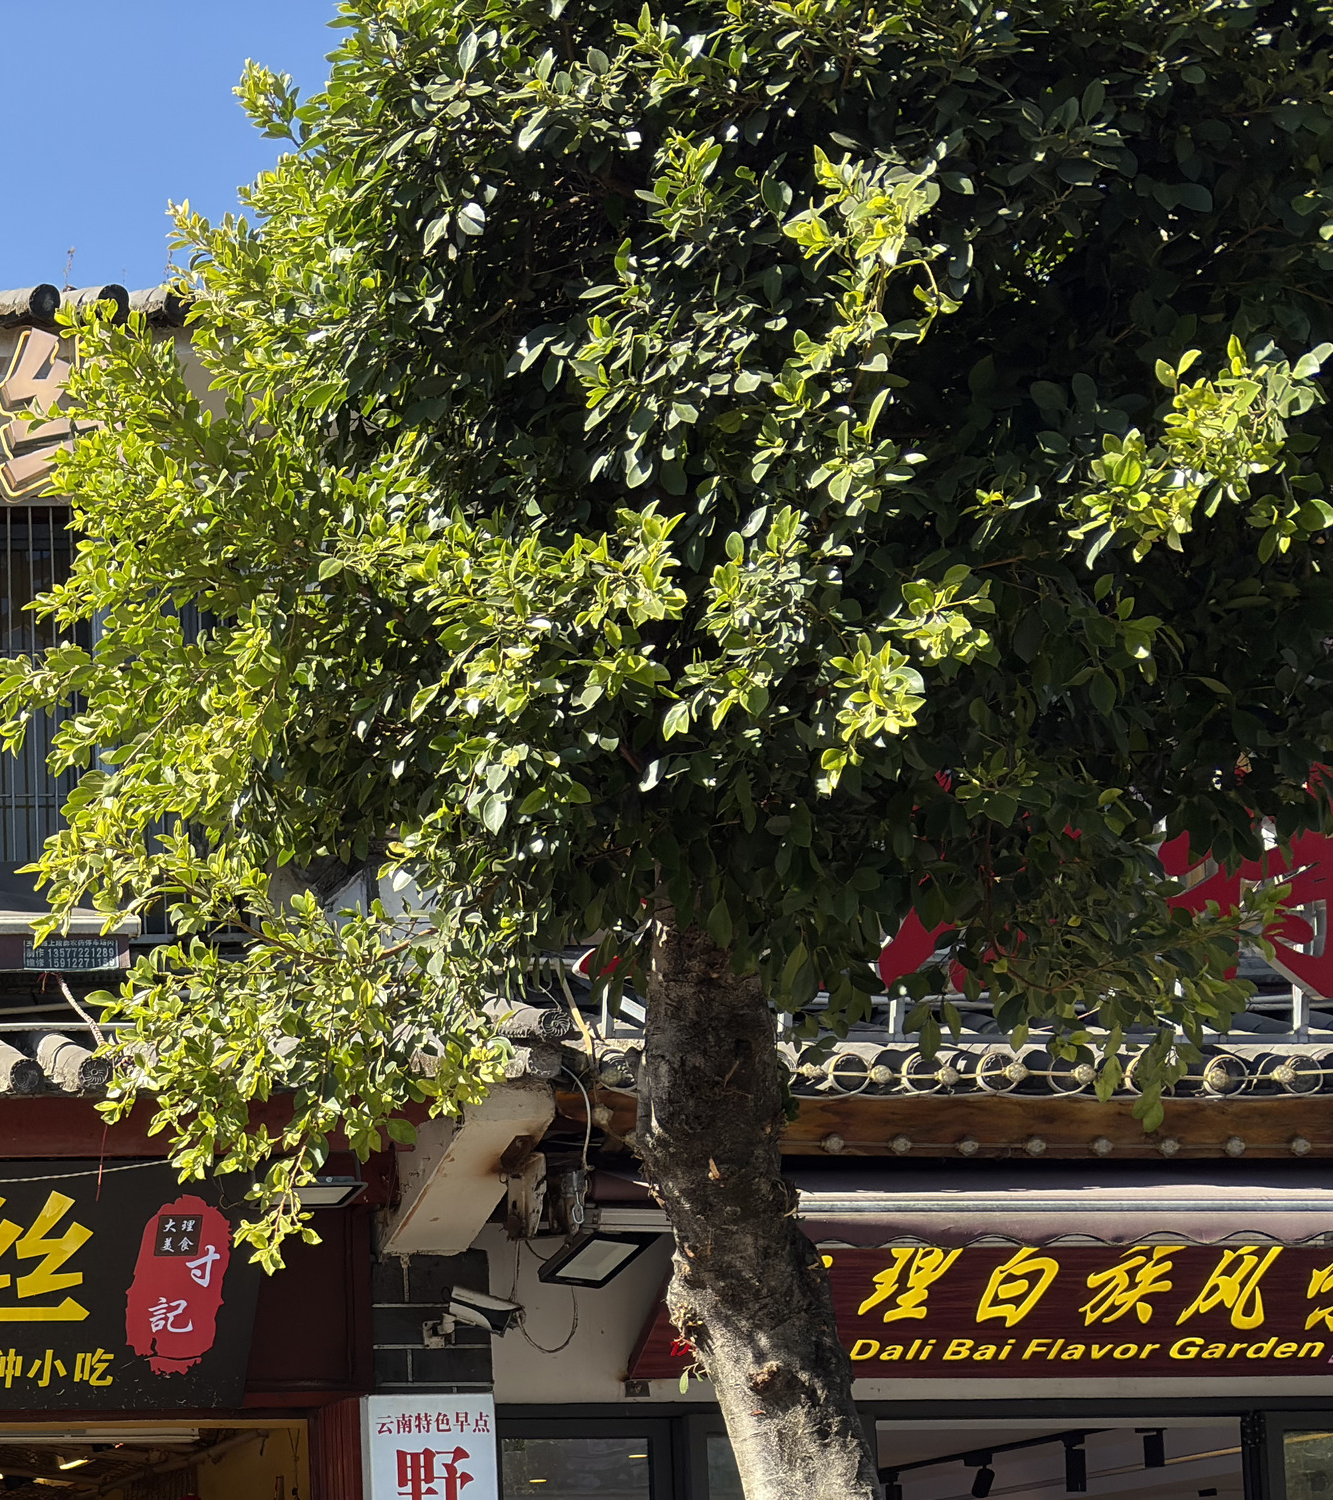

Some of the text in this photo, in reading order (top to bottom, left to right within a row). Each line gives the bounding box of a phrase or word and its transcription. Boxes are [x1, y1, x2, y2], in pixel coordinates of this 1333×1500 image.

[163, 1218, 196, 1234] 大理
[161, 1236, 195, 1252] 美食
[849, 1336, 1325, 1362] Dali Bai Flavor Garden
[375, 1410, 492, 1436] 云南特色早点
